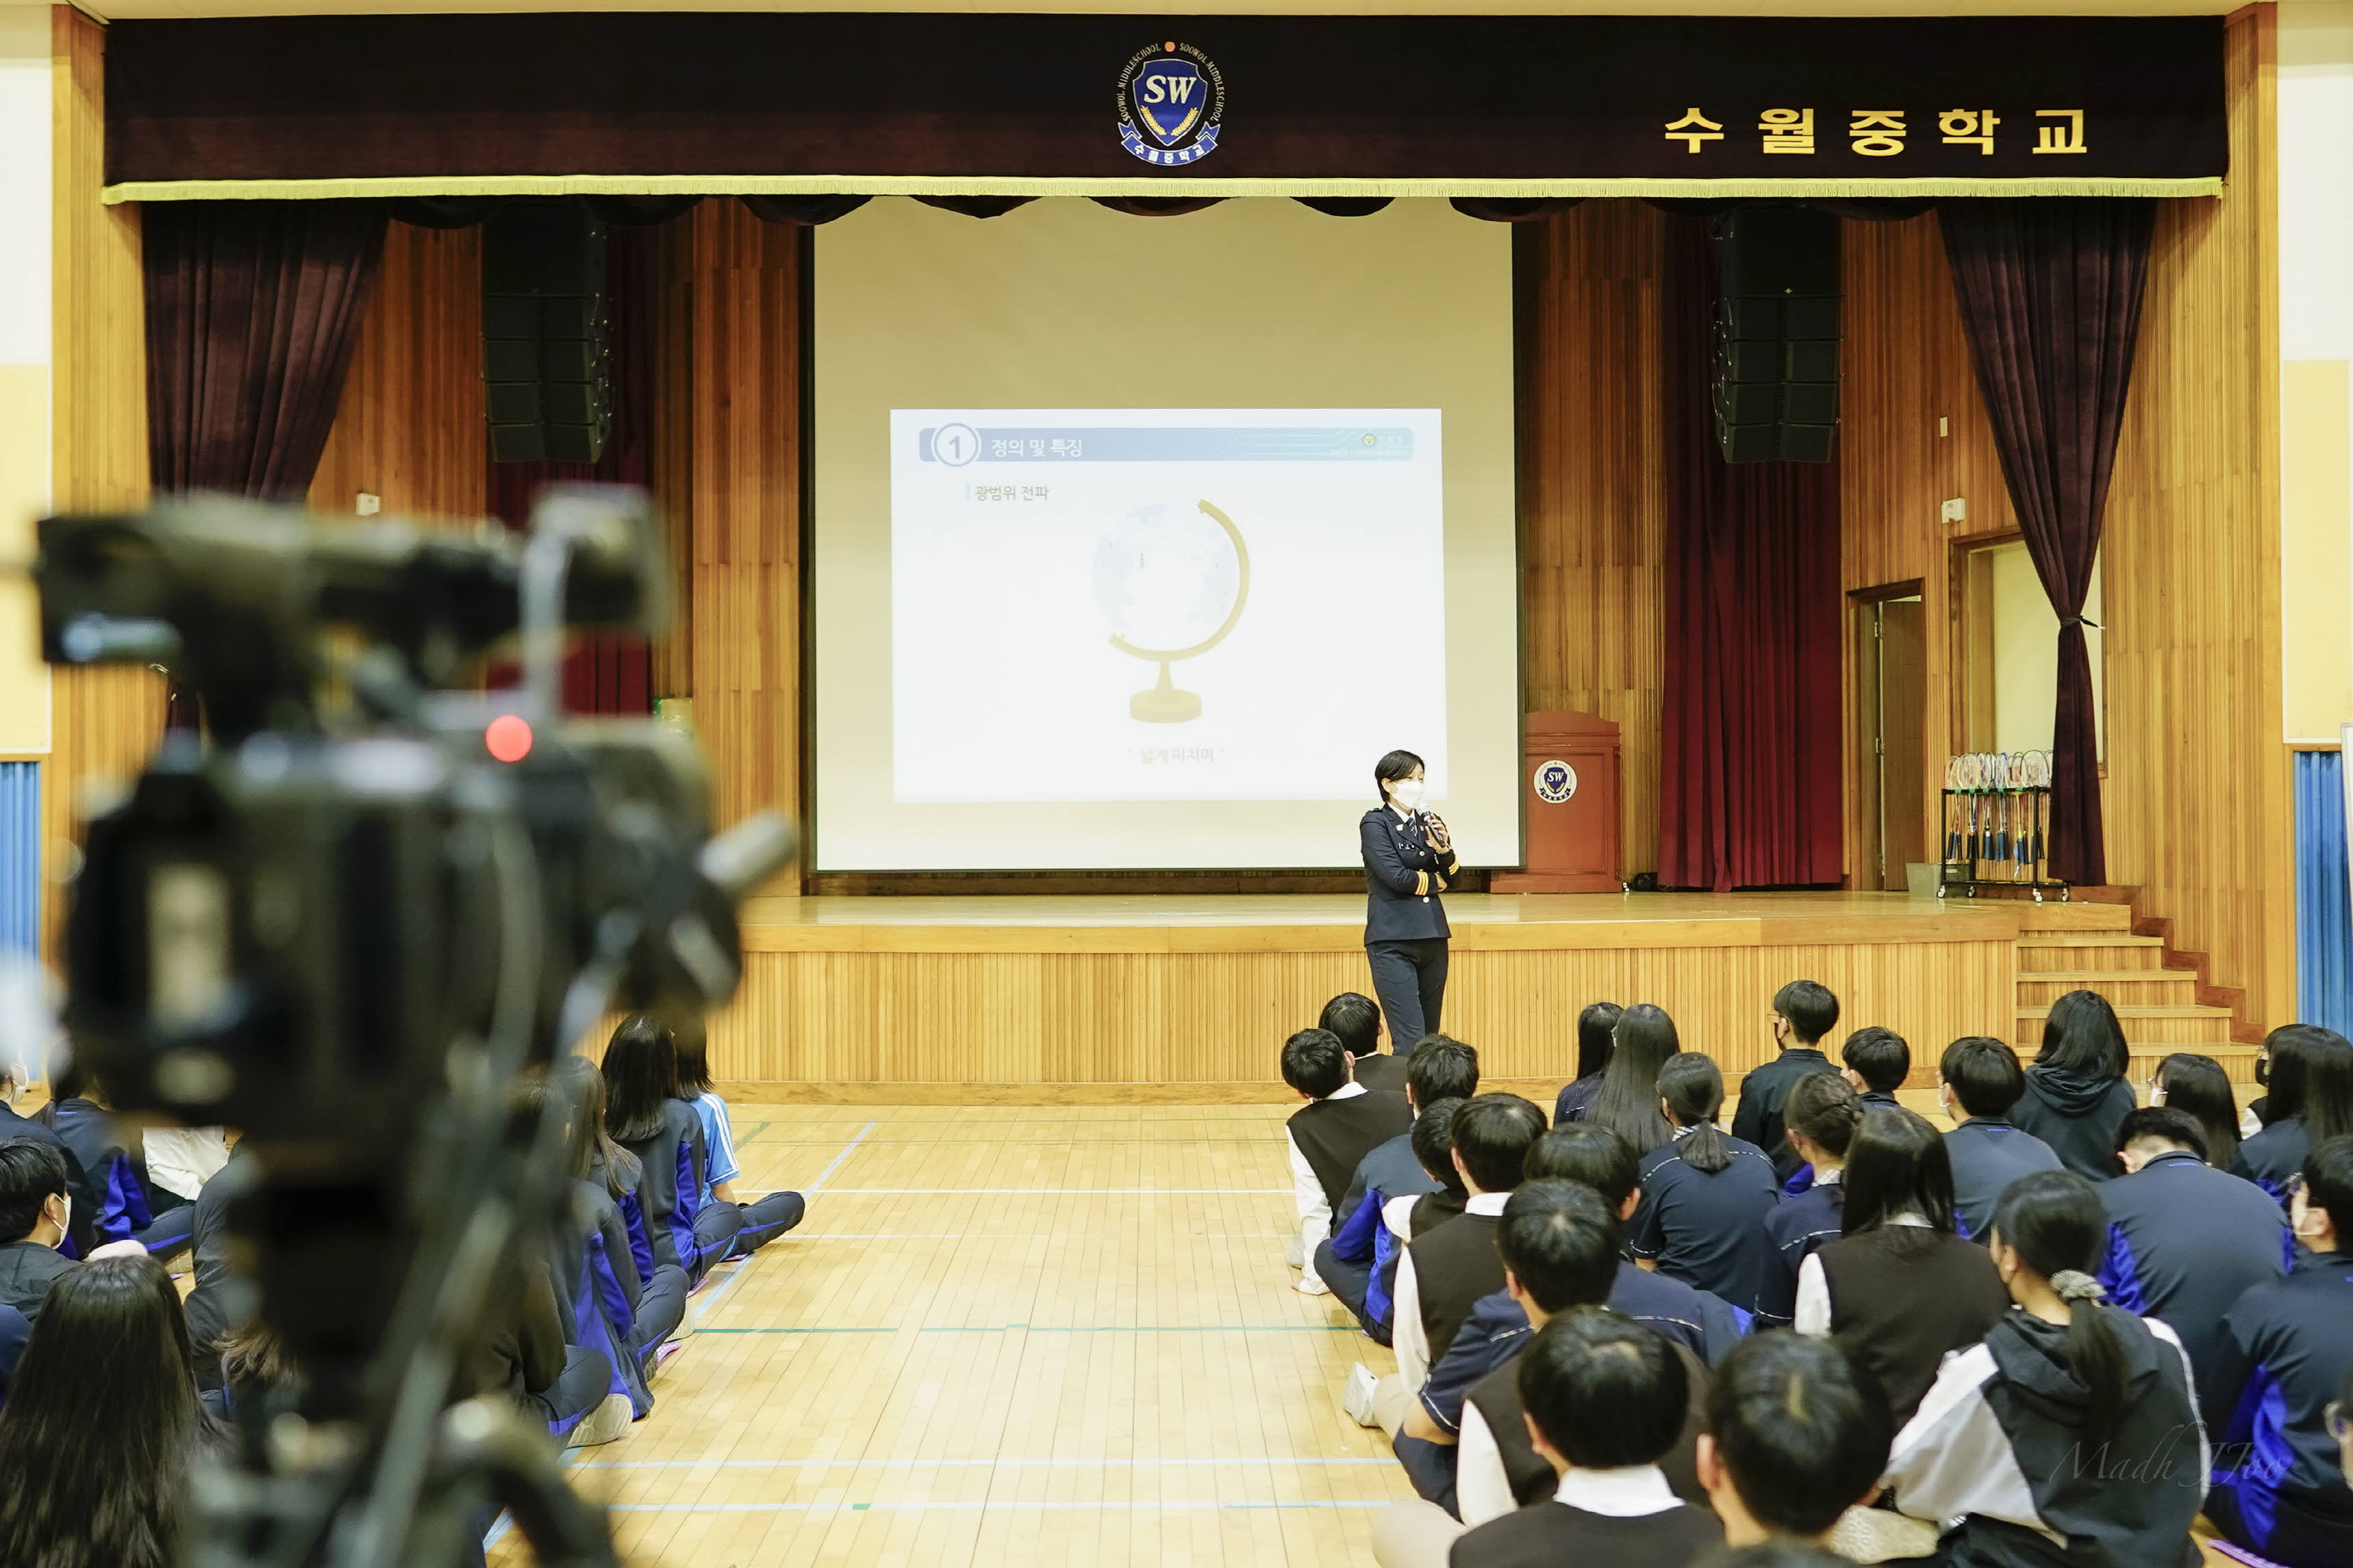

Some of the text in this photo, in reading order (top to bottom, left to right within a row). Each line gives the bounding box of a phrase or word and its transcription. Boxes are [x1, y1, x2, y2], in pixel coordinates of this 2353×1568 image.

[1144, 75, 1197, 103] SW
[948, 435, 1083, 459] 1 정의 및 특징
[975, 486, 1049, 502] 광범위 전파
[1548, 772, 1564, 782] SW
